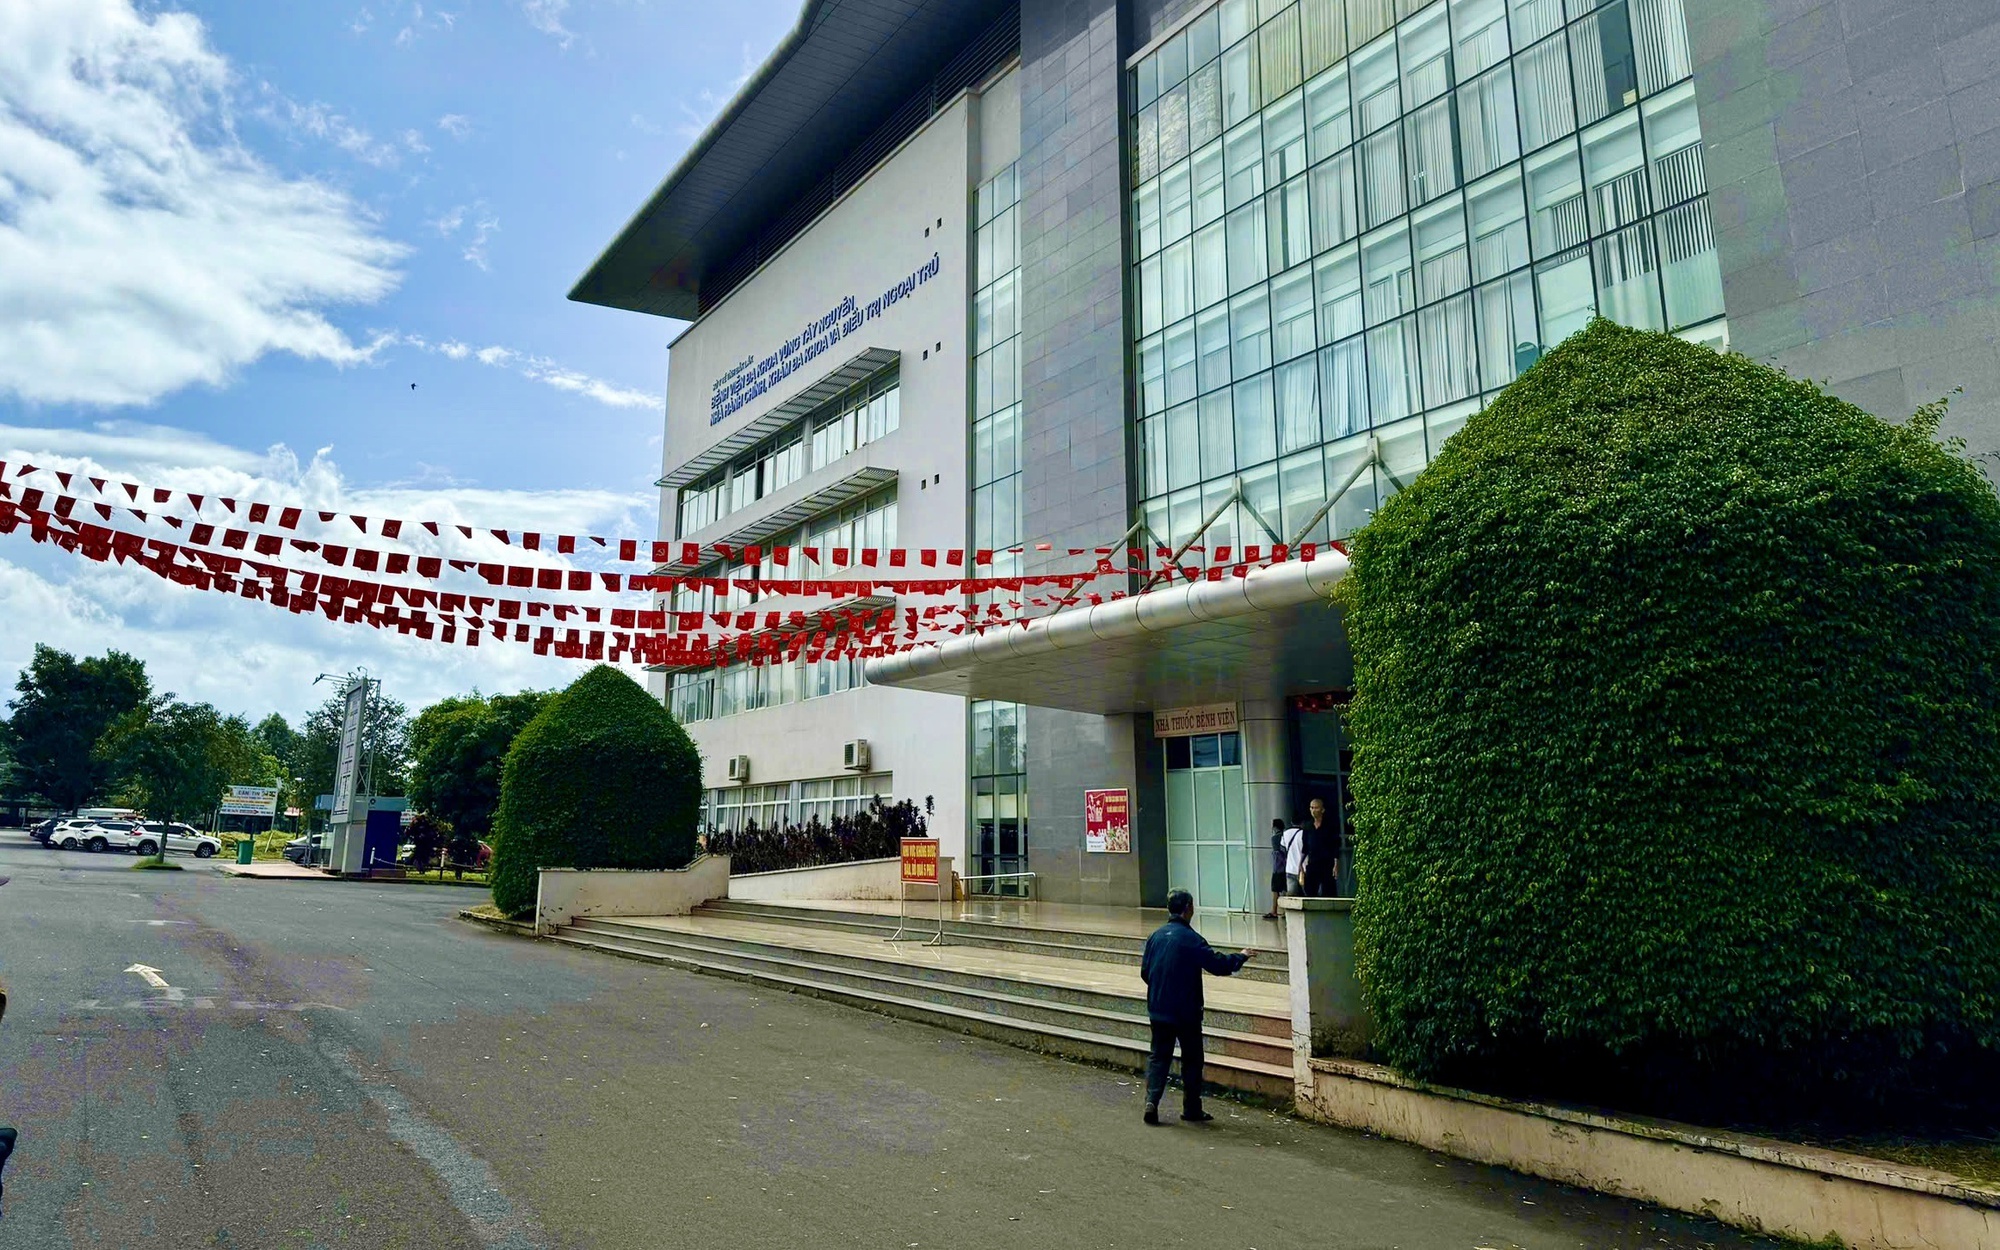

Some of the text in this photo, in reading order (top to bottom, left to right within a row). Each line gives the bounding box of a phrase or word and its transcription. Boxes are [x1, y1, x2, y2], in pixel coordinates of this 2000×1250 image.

[710, 404, 724, 427] NHÀ
[725, 393, 744, 418] HÀNH
[768, 361, 792, 388] KHÁM
[792, 352, 804, 372] ĐA
[804, 335, 829, 364] KHOA
[829, 322, 841, 346] VÀ
[842, 307, 864, 338] ĐIỀU
[865, 297, 881, 321] TRỊ
[883, 272, 916, 310] NGOẠI
[917, 251, 940, 285] TRÚ
[711, 295, 855, 409] BỆNH VIỆN ĐA KHOA VÙNG TÂY NGUYÊN
[1155, 707, 1235, 732] NHÀ THUỐC BỆNH VIỆN
